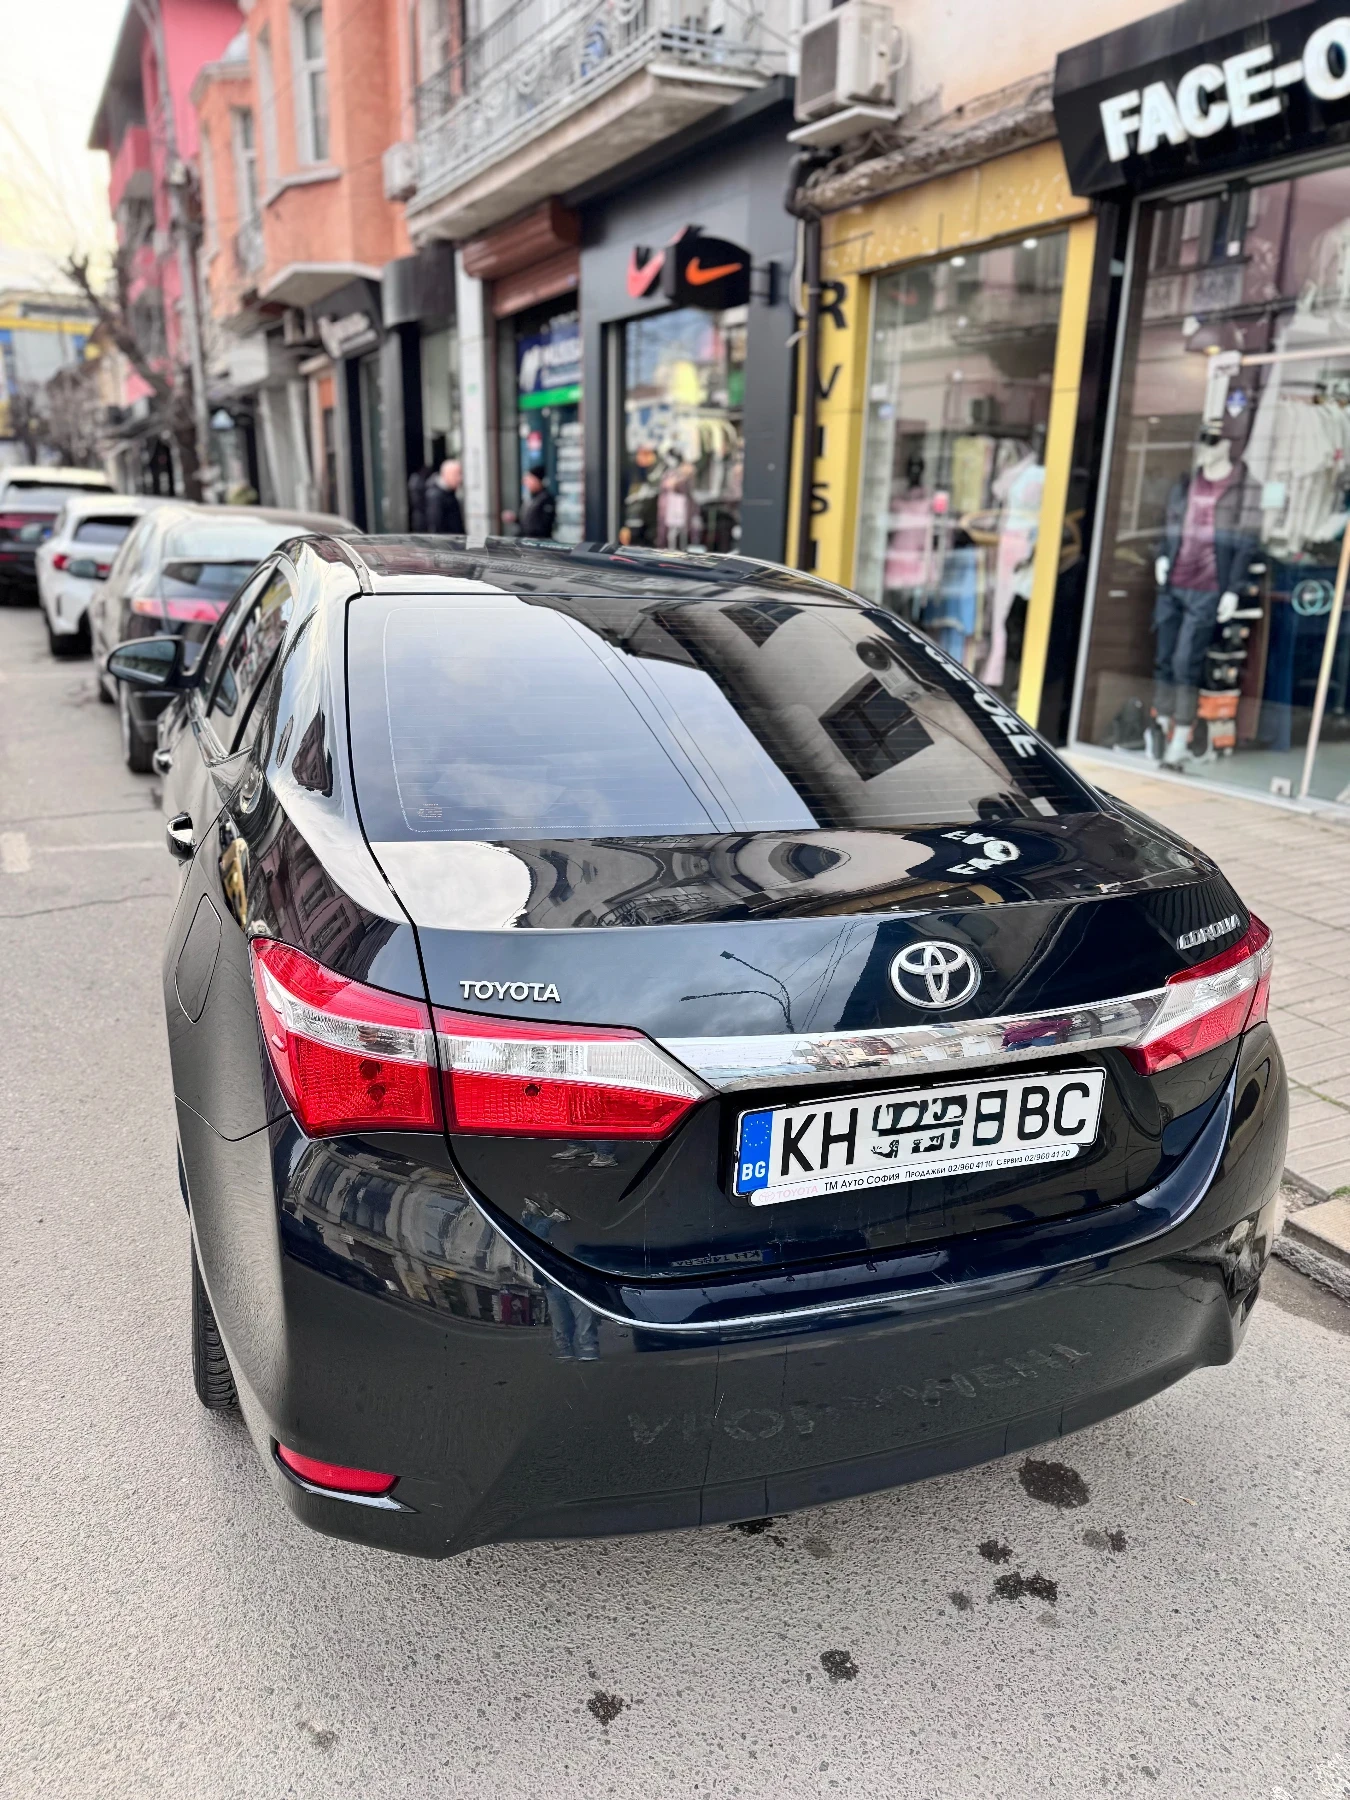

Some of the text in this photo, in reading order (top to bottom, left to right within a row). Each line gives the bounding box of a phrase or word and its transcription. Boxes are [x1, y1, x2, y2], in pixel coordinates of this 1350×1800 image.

[459, 980, 561, 1003] TOYOTA
[741, 1160, 766, 1181] BG
[776, 1185, 818, 1200] TOYOTA
